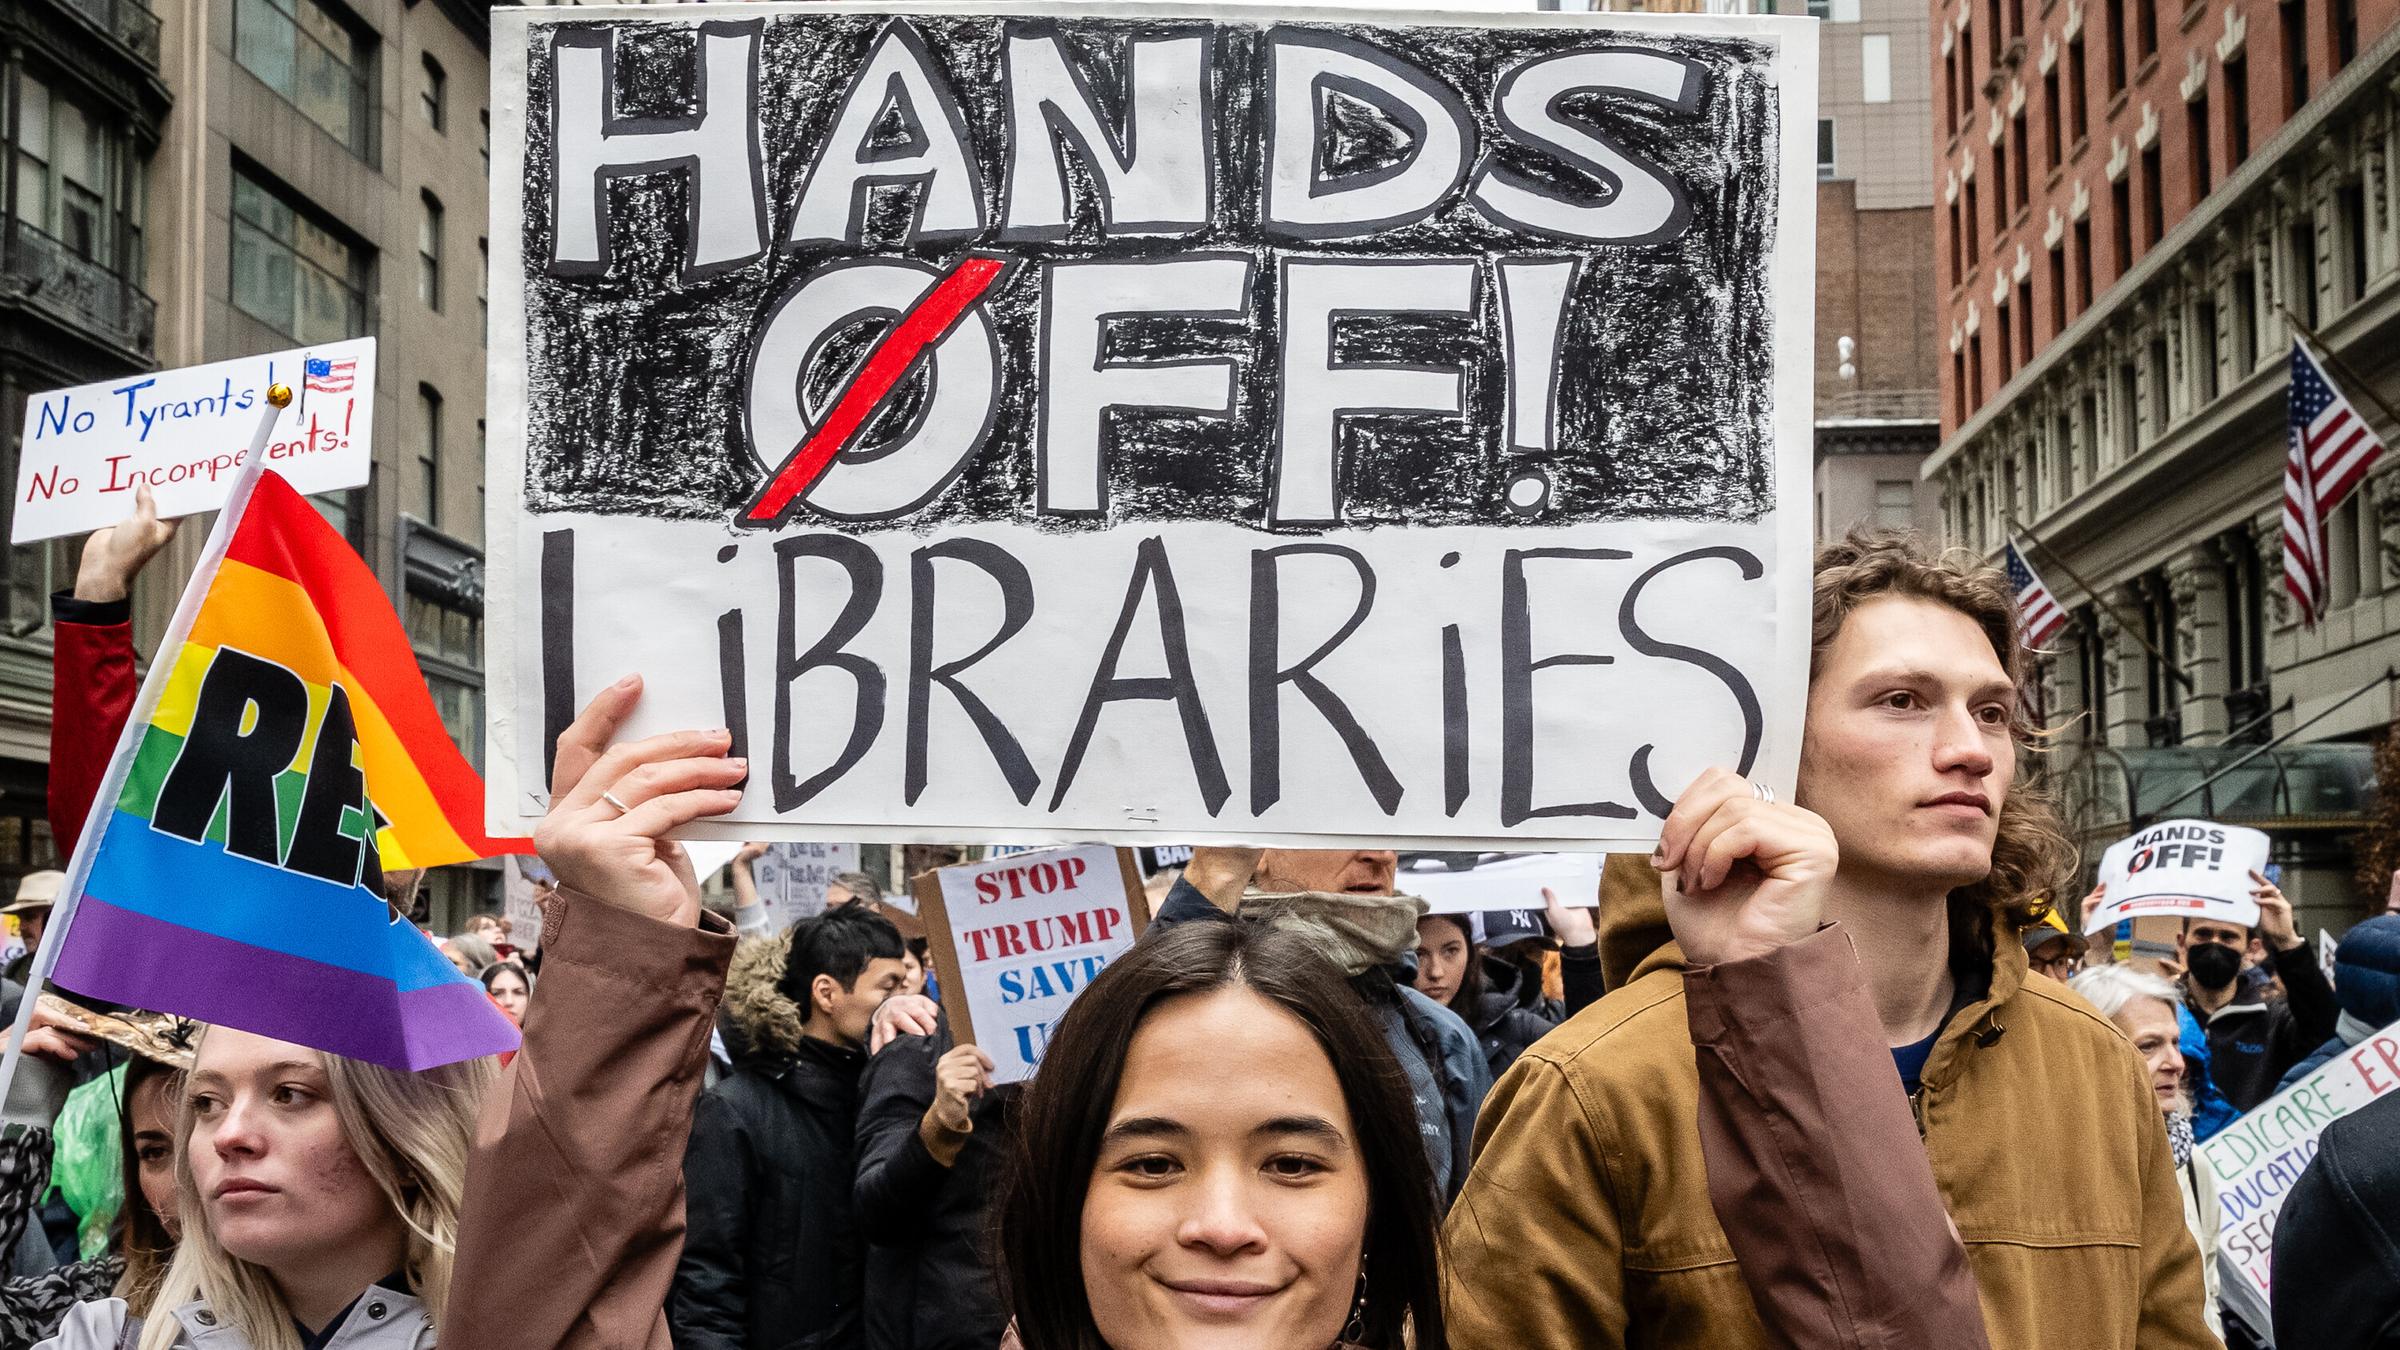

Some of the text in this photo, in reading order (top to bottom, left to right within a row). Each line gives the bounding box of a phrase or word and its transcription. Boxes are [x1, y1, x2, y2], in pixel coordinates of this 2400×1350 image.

[549, 17, 1707, 278] HANDS
[27, 398, 354, 502] No Incompeents!
[36, 395, 95, 440] No
[2133, 826, 2225, 850] HANDS
[974, 857, 1086, 905] STOP
[963, 907, 1121, 962] TRUMP
[2203, 1075, 2347, 1180] EDICARE
[2219, 1137, 2320, 1232] DUCATIO
